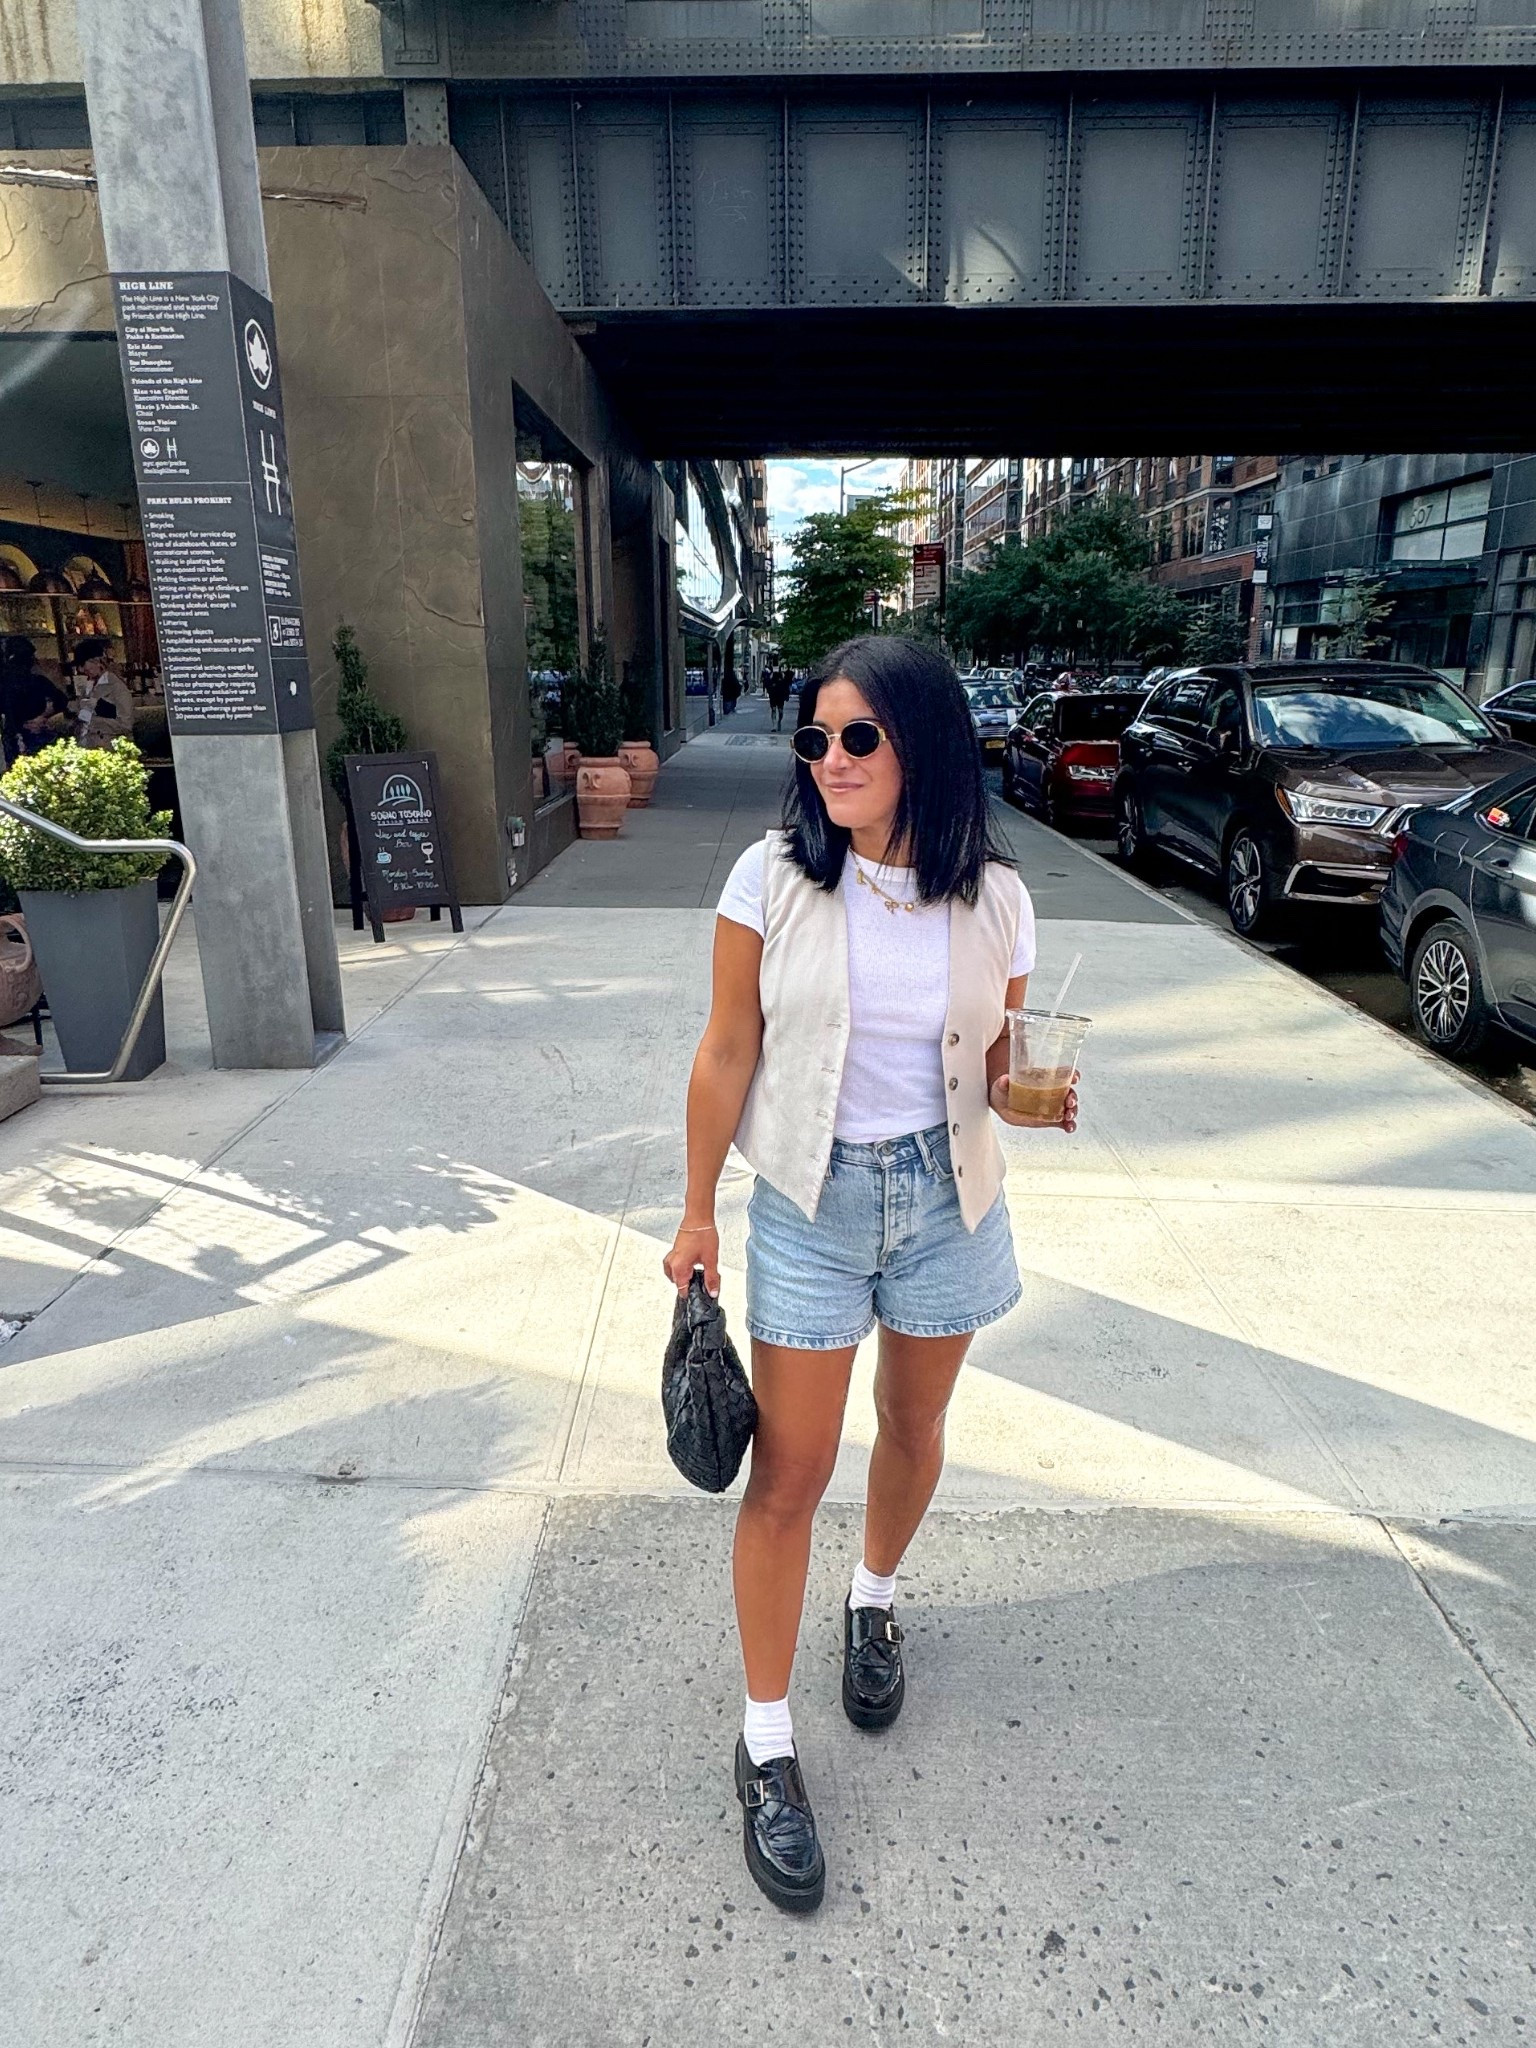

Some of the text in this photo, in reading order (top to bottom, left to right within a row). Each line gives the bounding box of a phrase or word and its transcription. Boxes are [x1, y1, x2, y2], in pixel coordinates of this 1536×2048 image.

[118, 282, 174, 290] HIGH LINE
[133, 295, 148, 304] High
[191, 294, 205, 302] York
[206, 294, 220, 303] City
[175, 313, 190, 321] High
[150, 522, 174, 530] Bicycles
[221, 531, 236, 539] dogs
[155, 559, 179, 567] Walking
[186, 558, 210, 566] planting
[172, 566, 196, 574] exposed
[209, 575, 228, 583] plants
[215, 584, 240, 592] climbing
[160, 602, 185, 610] Drinking
[163, 619, 188, 627] Littering
[170, 672, 189, 680] permit
[216, 696, 224, 704] by
[226, 712, 233, 720] by
